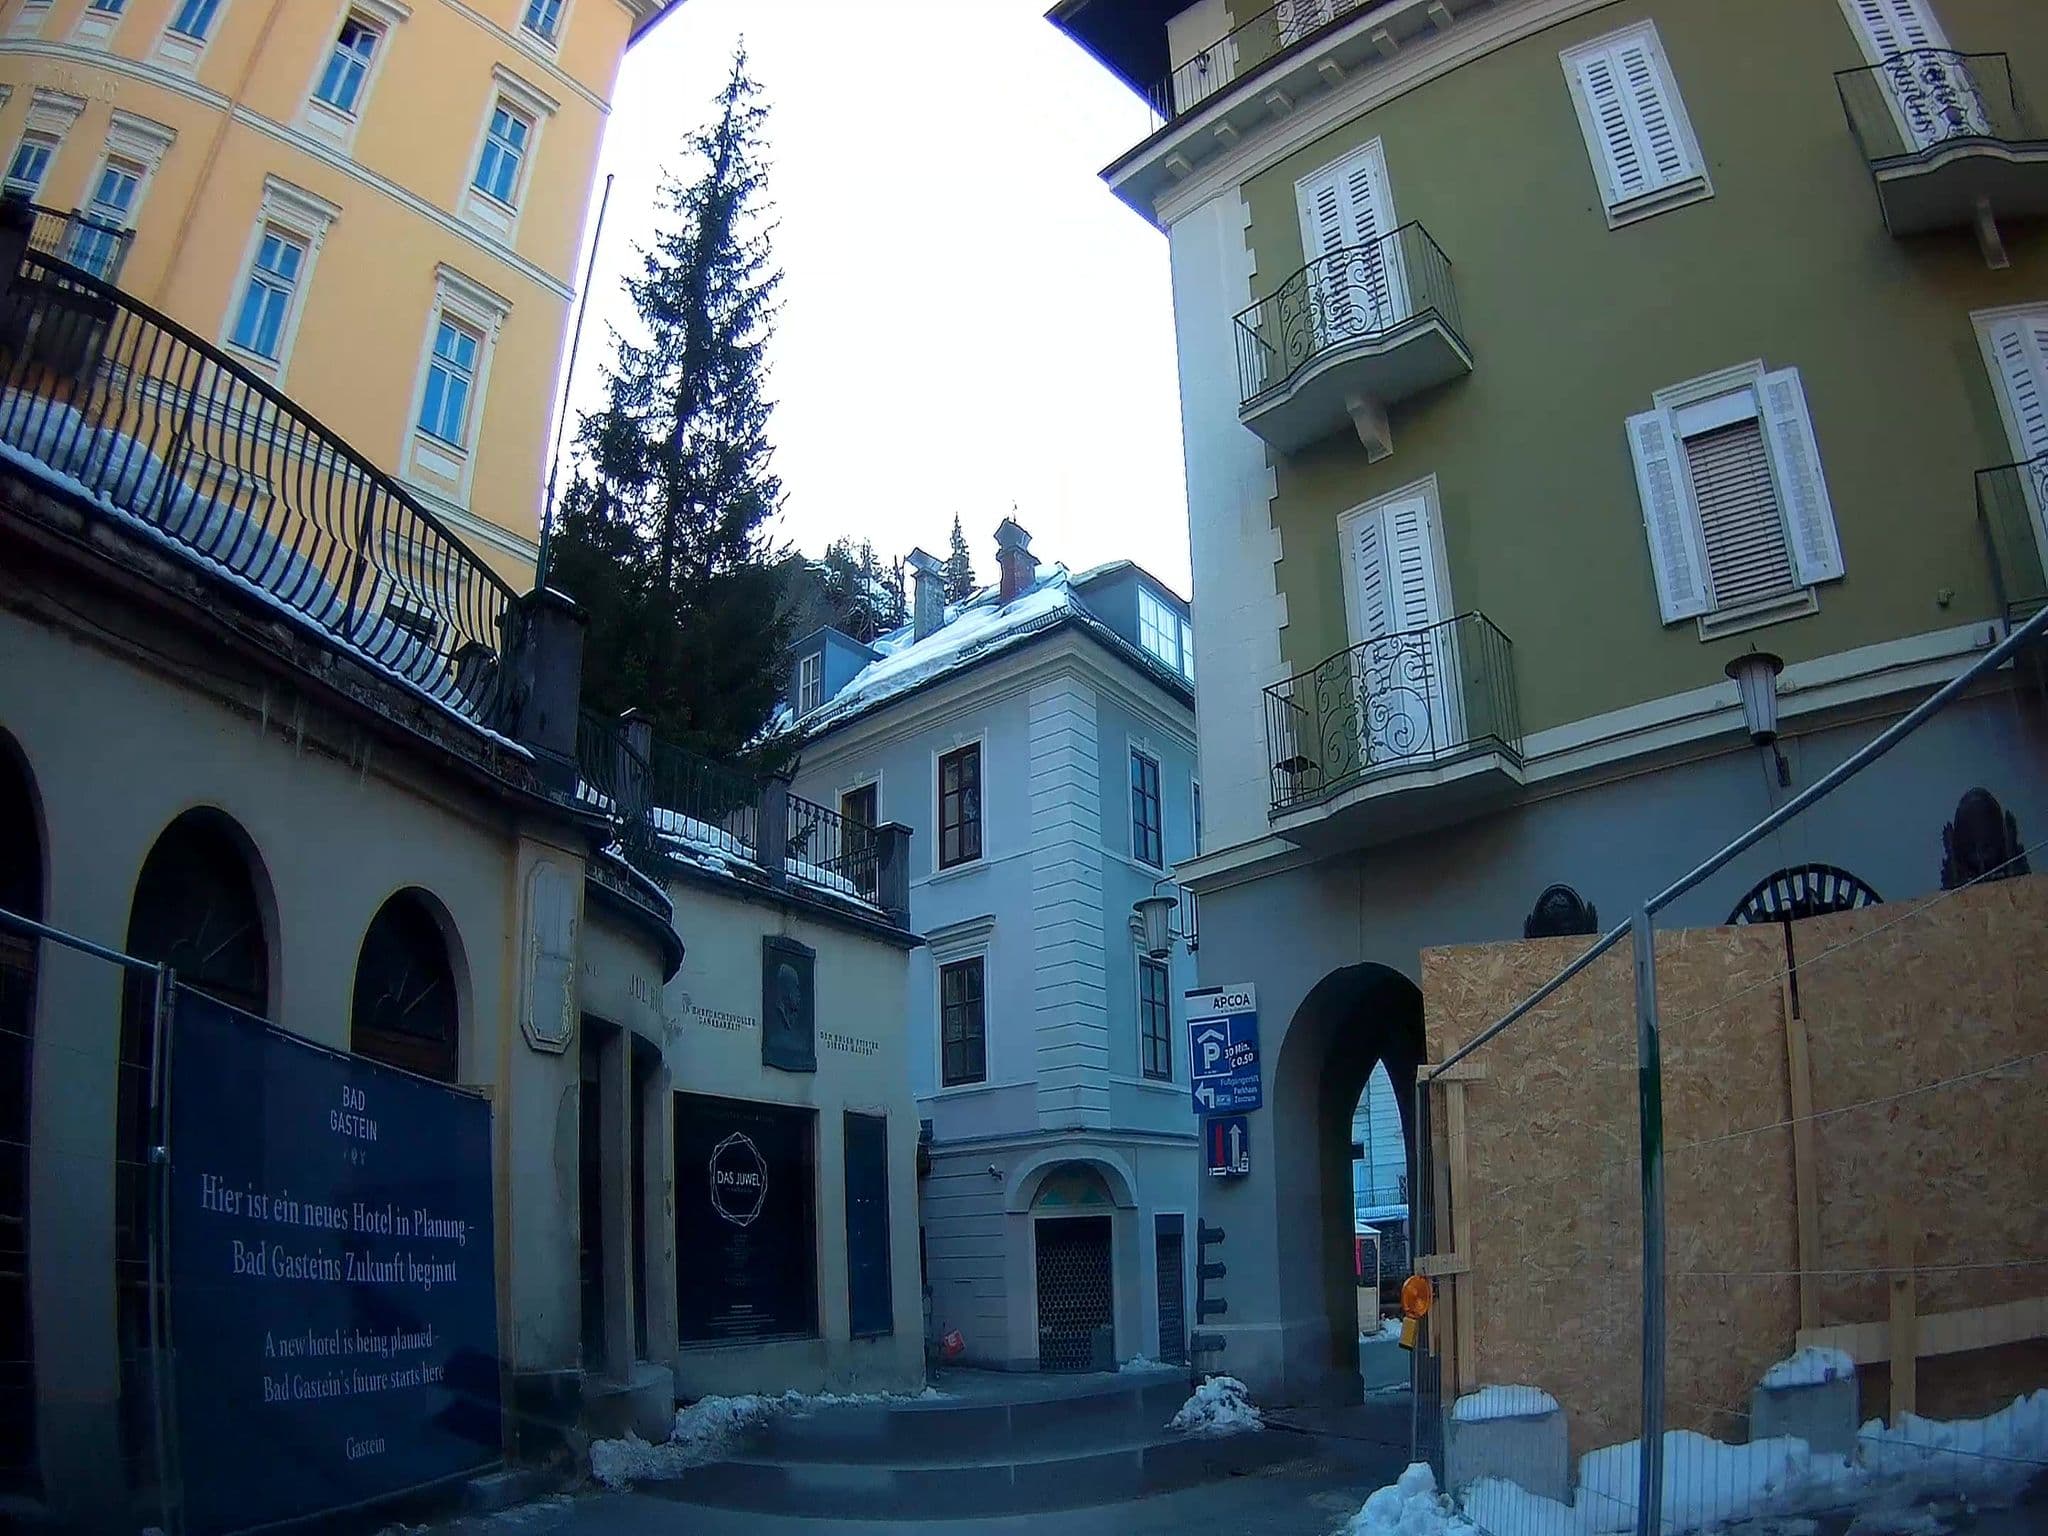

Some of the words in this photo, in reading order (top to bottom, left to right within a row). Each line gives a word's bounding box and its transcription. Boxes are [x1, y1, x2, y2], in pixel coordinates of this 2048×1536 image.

[1213, 993, 1251, 1009] APCOA
[1224, 1047, 1234, 1059] 30
[343, 1085, 365, 1111] BAD
[330, 1109, 377, 1141] GASTEIN
[716, 1170, 735, 1186] DAS
[735, 1172, 761, 1187] JUWEL
[200, 1173, 243, 1215] Hier
[247, 1181, 269, 1220] ist
[273, 1188, 300, 1225] ein
[303, 1202, 349, 1231] neues
[352, 1202, 392, 1236] Hotel
[396, 1206, 410, 1236] in
[413, 1207, 466, 1247] Planung
[232, 1240, 267, 1276] Bad
[272, 1244, 342, 1281] Gasteins
[345, 1250, 405, 1282] Zukunft
[407, 1251, 457, 1292] beginnt
[265, 1330, 277, 1358] A
[279, 1337, 306, 1358] new
[308, 1328, 341, 1357] hotel
[343, 1329, 354, 1355] is
[355, 1328, 389, 1358] being
[390, 1323, 433, 1358] planned
[264, 1373, 290, 1402] Bad
[293, 1369, 351, 1401] Gastein's
[353, 1367, 388, 1394] future
[390, 1365, 421, 1389] starts
[422, 1360, 445, 1384] here
[345, 1434, 386, 1461] Gastein
